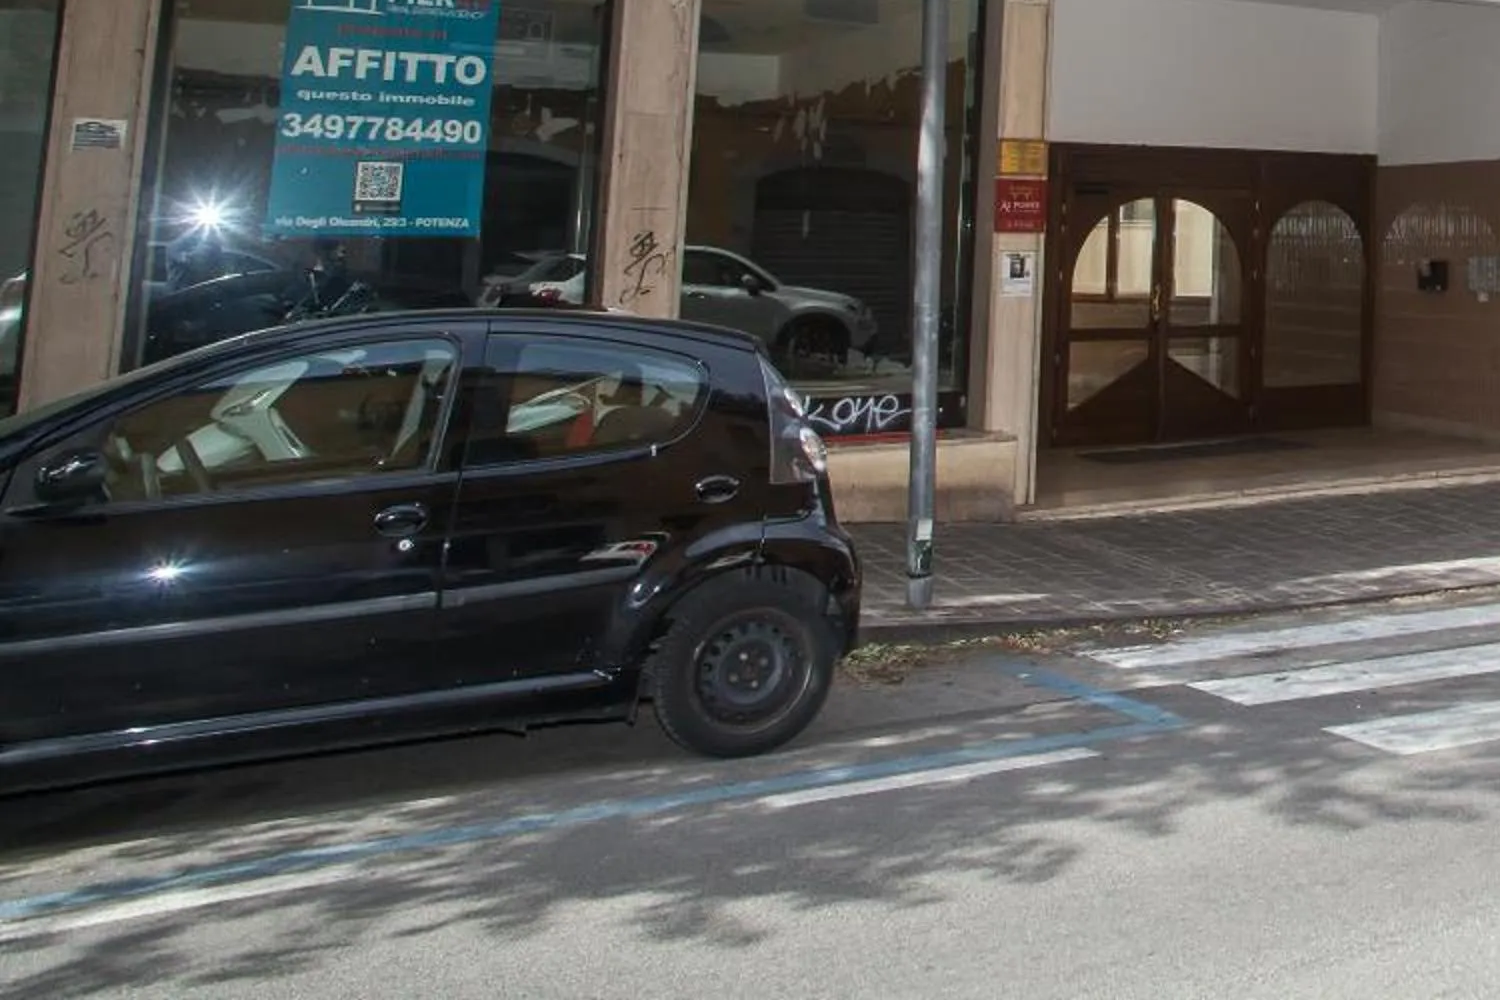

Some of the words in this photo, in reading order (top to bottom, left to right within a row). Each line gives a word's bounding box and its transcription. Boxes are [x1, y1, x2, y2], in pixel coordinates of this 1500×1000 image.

[290, 45, 487, 86] AFFITTO
[296, 88, 372, 101] questo
[378, 91, 476, 106] immobile
[281, 112, 482, 144] 3497784490
[415, 217, 470, 229] POTENZA
